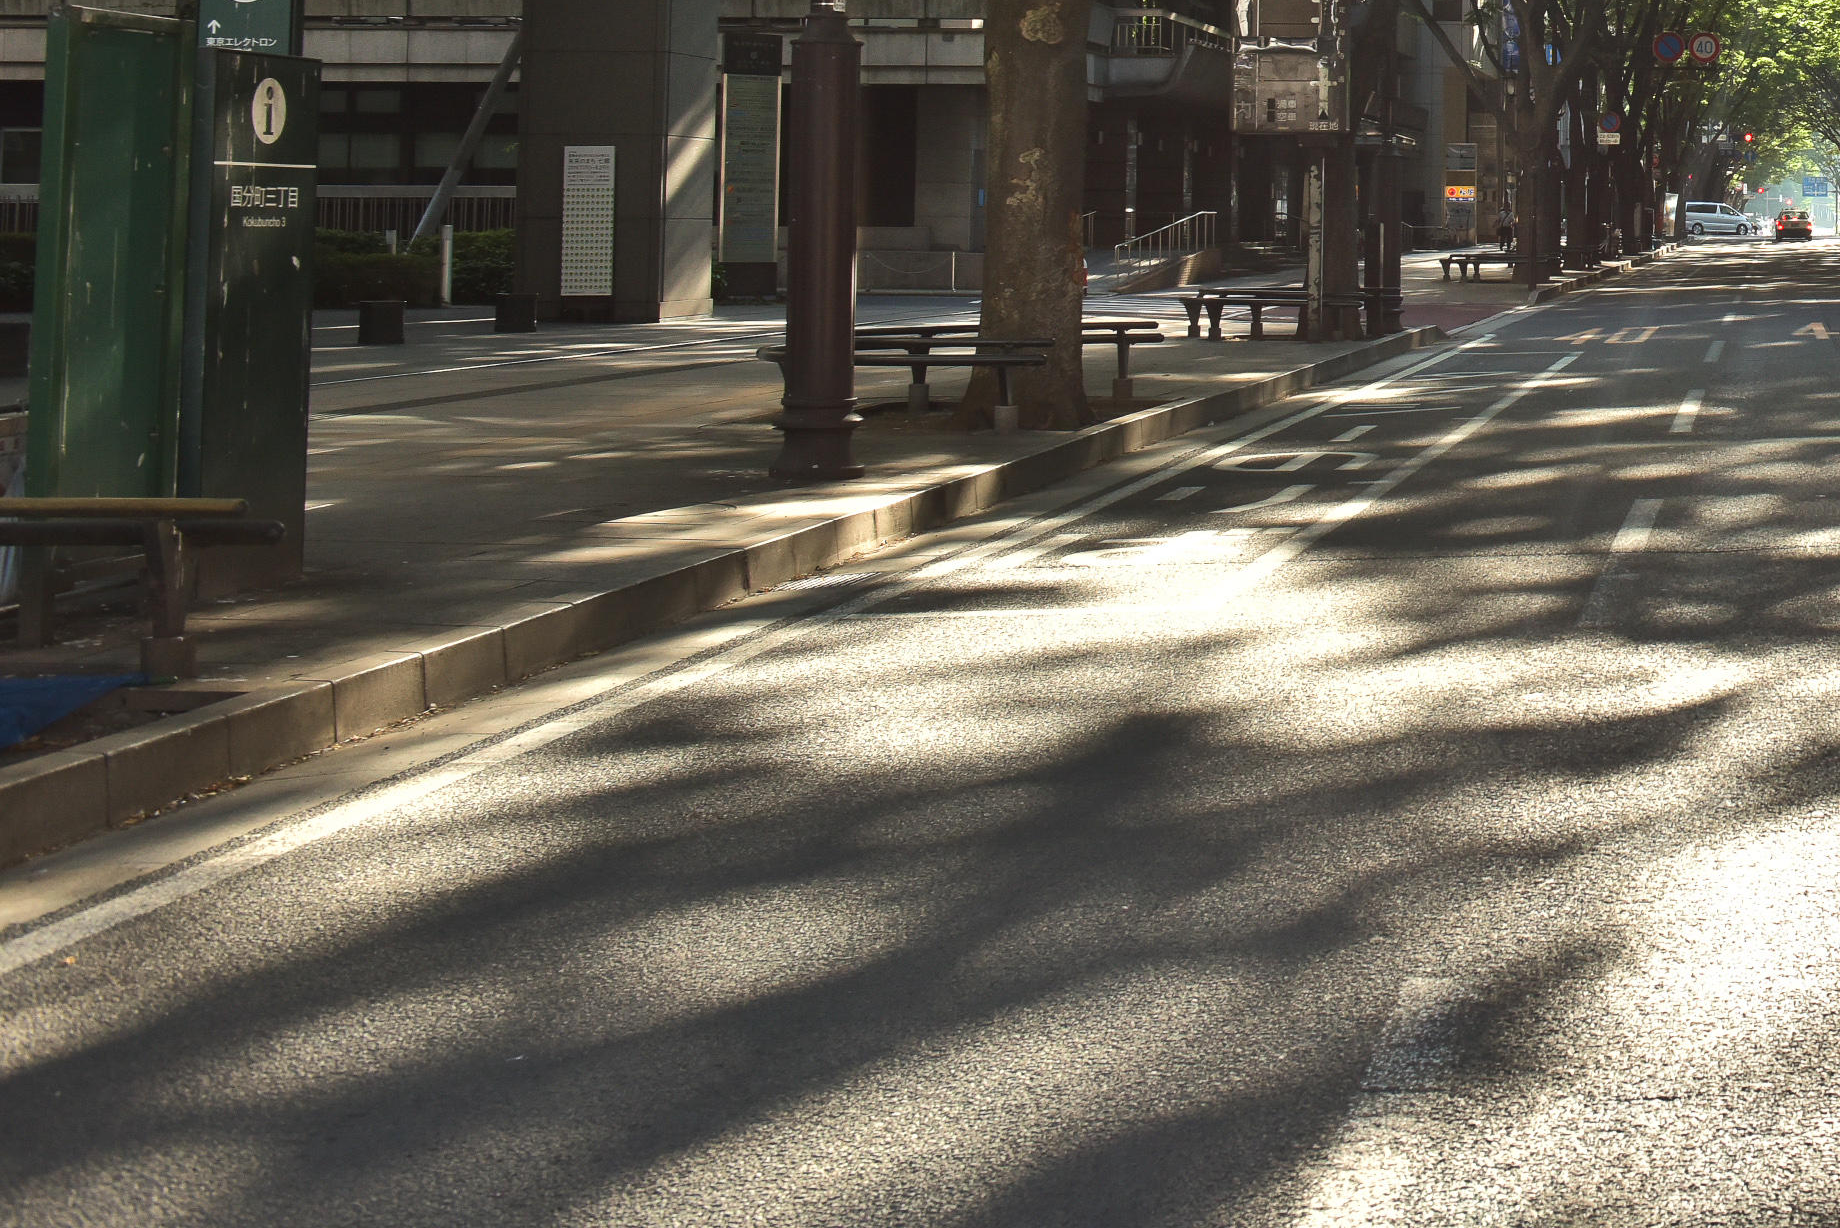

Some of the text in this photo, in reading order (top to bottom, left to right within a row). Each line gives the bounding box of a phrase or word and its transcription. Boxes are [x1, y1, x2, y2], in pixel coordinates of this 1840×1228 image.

[205, 37, 277, 47] 東京エレクトロン
[1695, 40, 1714, 54] 40
[1309, 122, 1338, 131] 現在地
[231, 185, 299, 208] 国分町三丁目
[243, 216, 287, 227] Kokubuncho 3
[1553, 326, 1660, 345] 40
